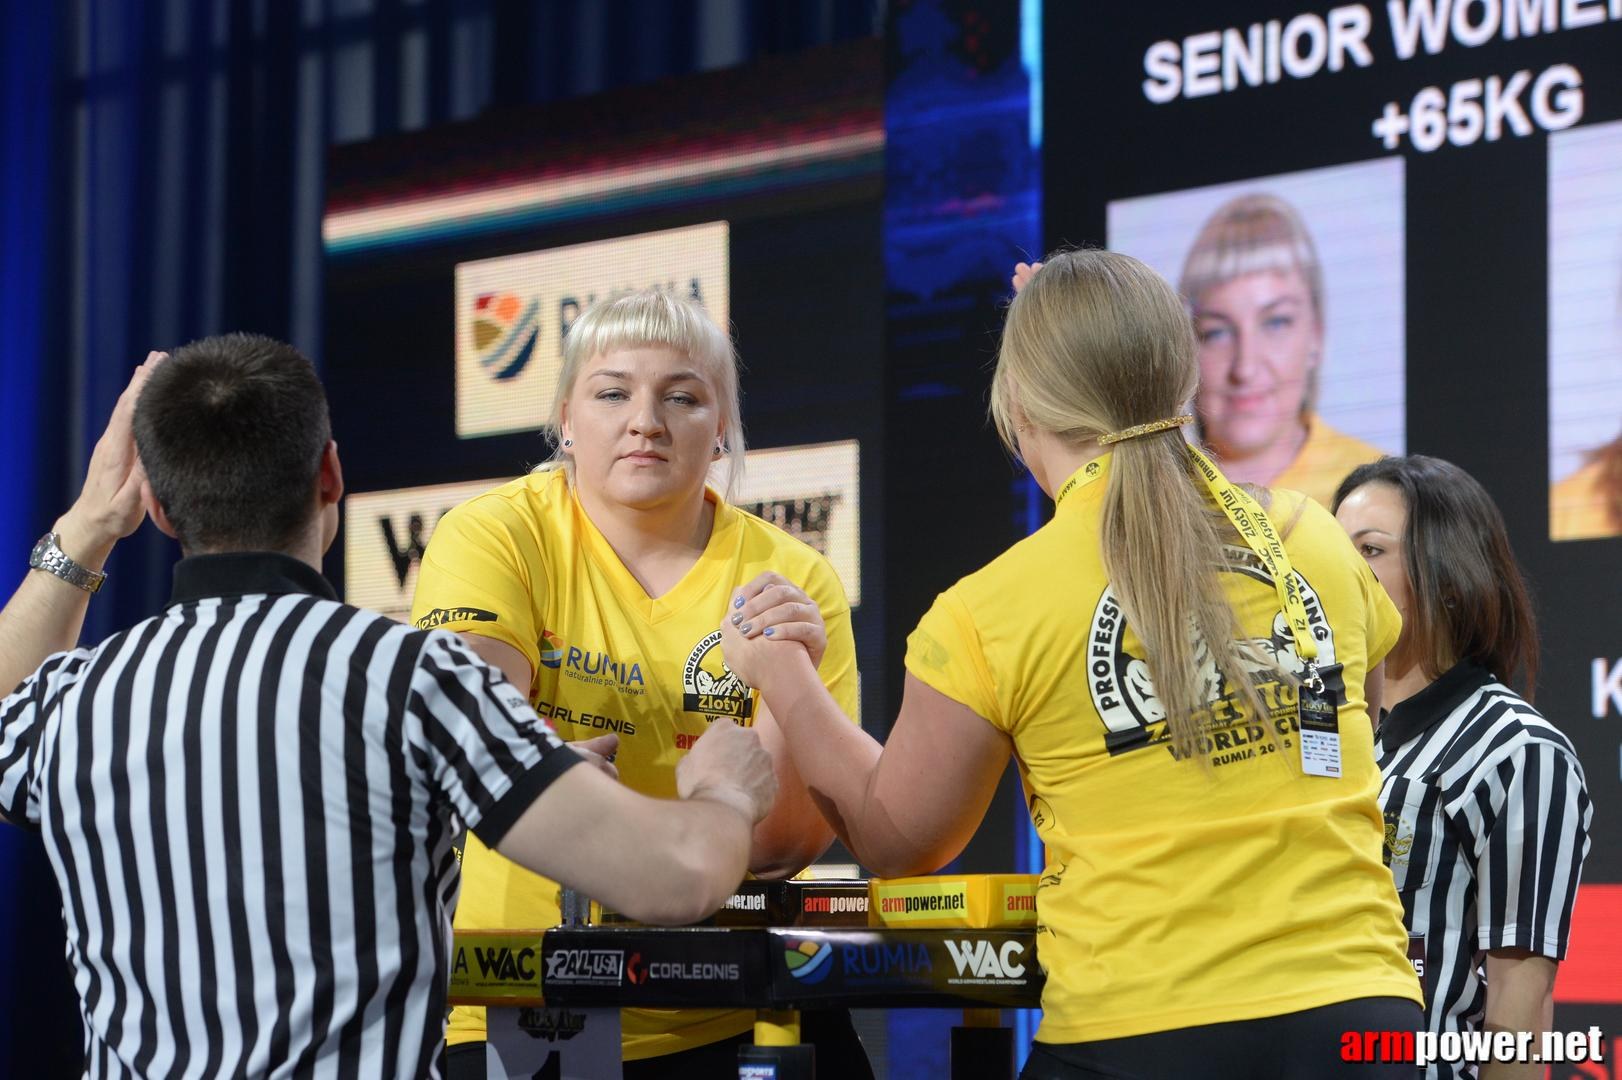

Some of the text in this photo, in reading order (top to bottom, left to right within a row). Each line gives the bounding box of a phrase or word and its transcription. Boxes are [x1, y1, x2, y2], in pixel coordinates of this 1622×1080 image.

[1143, 4, 1374, 104] SENIOR
[1372, 63, 1584, 152] +65KG
[1283, 573, 1299, 604] WAC
[566, 646, 645, 686] RUMIA
[698, 695, 740, 716] Zloty
[1213, 748, 1256, 768] RUMIA
[1260, 739, 1292, 757] 205
[882, 892, 964, 913] armpower.net
[474, 947, 536, 981] WAC
[593, 954, 619, 976] USA
[649, 962, 740, 980] CORLEONIS
[842, 943, 933, 976] RUMIA
[943, 940, 1026, 978] WAC
